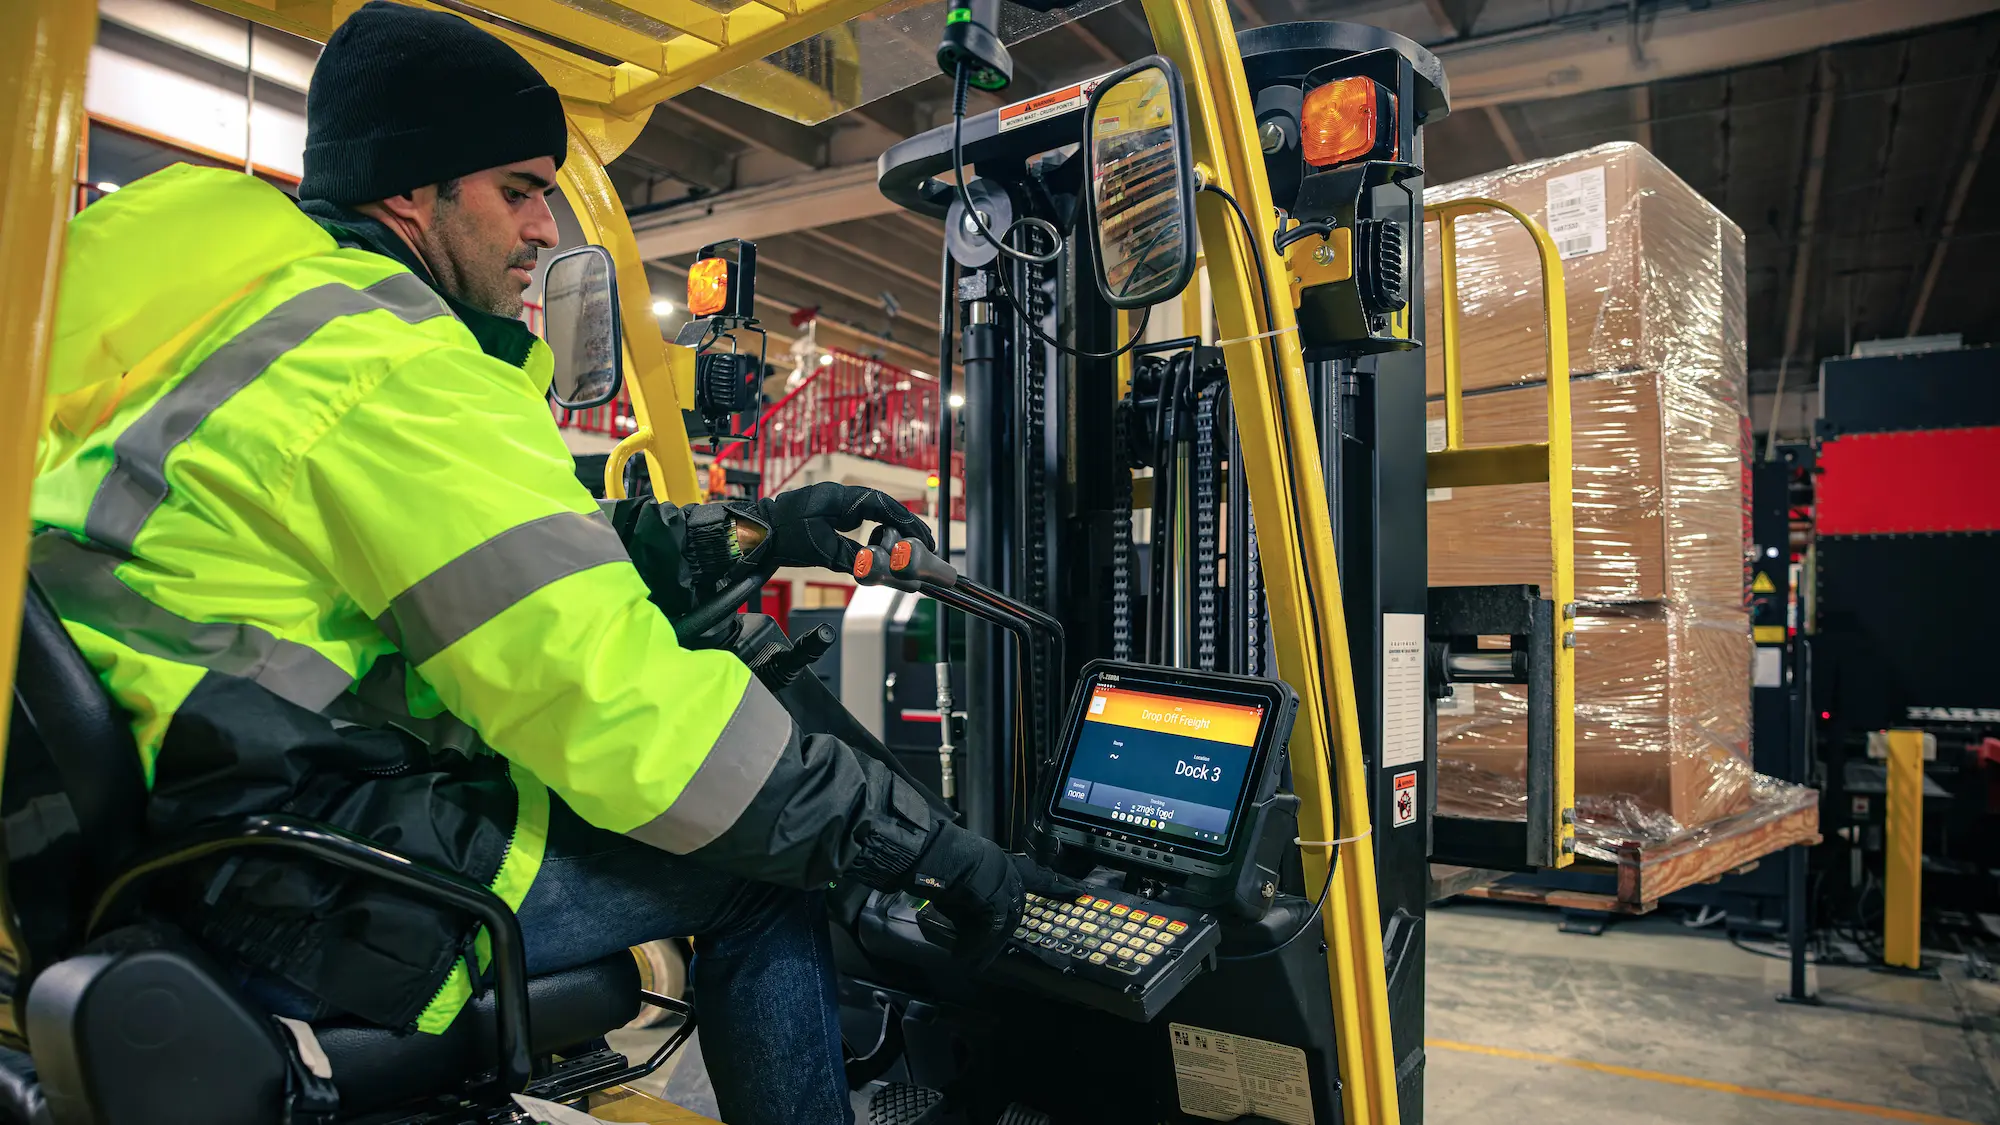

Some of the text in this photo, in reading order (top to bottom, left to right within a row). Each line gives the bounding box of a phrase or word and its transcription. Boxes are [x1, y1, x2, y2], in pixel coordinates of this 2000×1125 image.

[1033, 97, 1055, 108] WARNING
[1006, 117, 1024, 126] MOVING
[1141, 709, 1211, 730] Drop Off Freight
[1175, 760, 1222, 782] Dock 3
[1067, 789, 1085, 800] none
[1156, 806, 1175, 819] food
